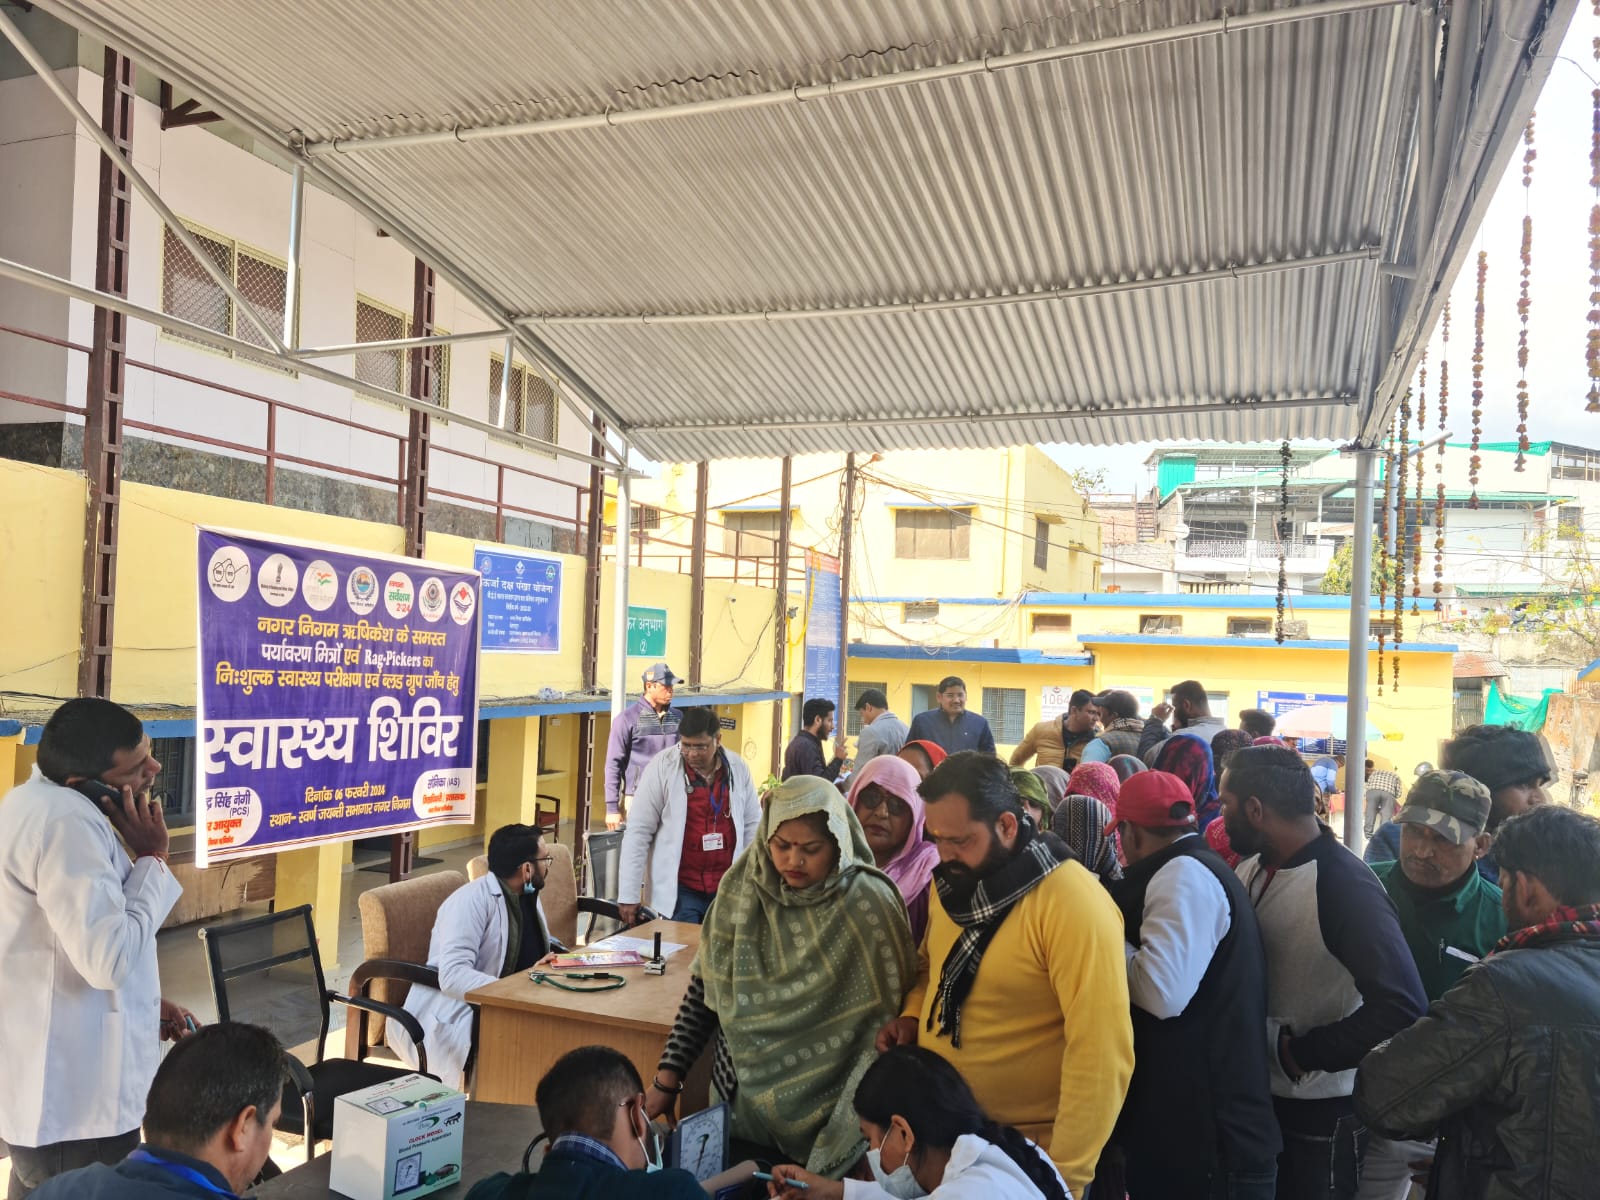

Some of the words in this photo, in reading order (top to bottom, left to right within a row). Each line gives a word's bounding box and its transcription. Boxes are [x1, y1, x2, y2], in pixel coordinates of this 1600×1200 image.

[258, 617, 295, 635] नगर
[298, 614, 340, 638] निगम
[342, 620, 394, 642] ऋषिकेश
[396, 624, 410, 643] के
[412, 630, 446, 646] समस्त
[639, 618, 664, 637] अनुभाग
[261, 638, 312, 662] पर्यावरण
[315, 640, 343, 664] मित्रों
[344, 644, 362, 665] एवं
[364, 649, 421, 669] Rag-Pickers
[423, 656, 434, 667] का
[278, 670, 321, 687] स्वास्थ्य
[325, 666, 362, 688] परीक्षण
[364, 668, 382, 688] एवं
[382, 674, 404, 689] ब्लड
[425, 670, 445, 688] जाँच
[447, 671, 459, 696] हेतु
[204, 717, 358, 775] स्वास्थ्य
[367, 696, 463, 762] शिविर
[215, 792, 232, 808] सिंह
[234, 790, 250, 806] नेगी
[305, 786, 333, 804] दिनांक
[230, 807, 249, 818] (PCS)
[299, 805, 317, 824] स्वर्ण
[318, 802, 344, 820] जयन्ती
[345, 803, 373, 817] सभागार
[374, 801, 391, 812] नगर
[392, 796, 411, 811] निगम
[213, 818, 242, 833] आयुक्त
